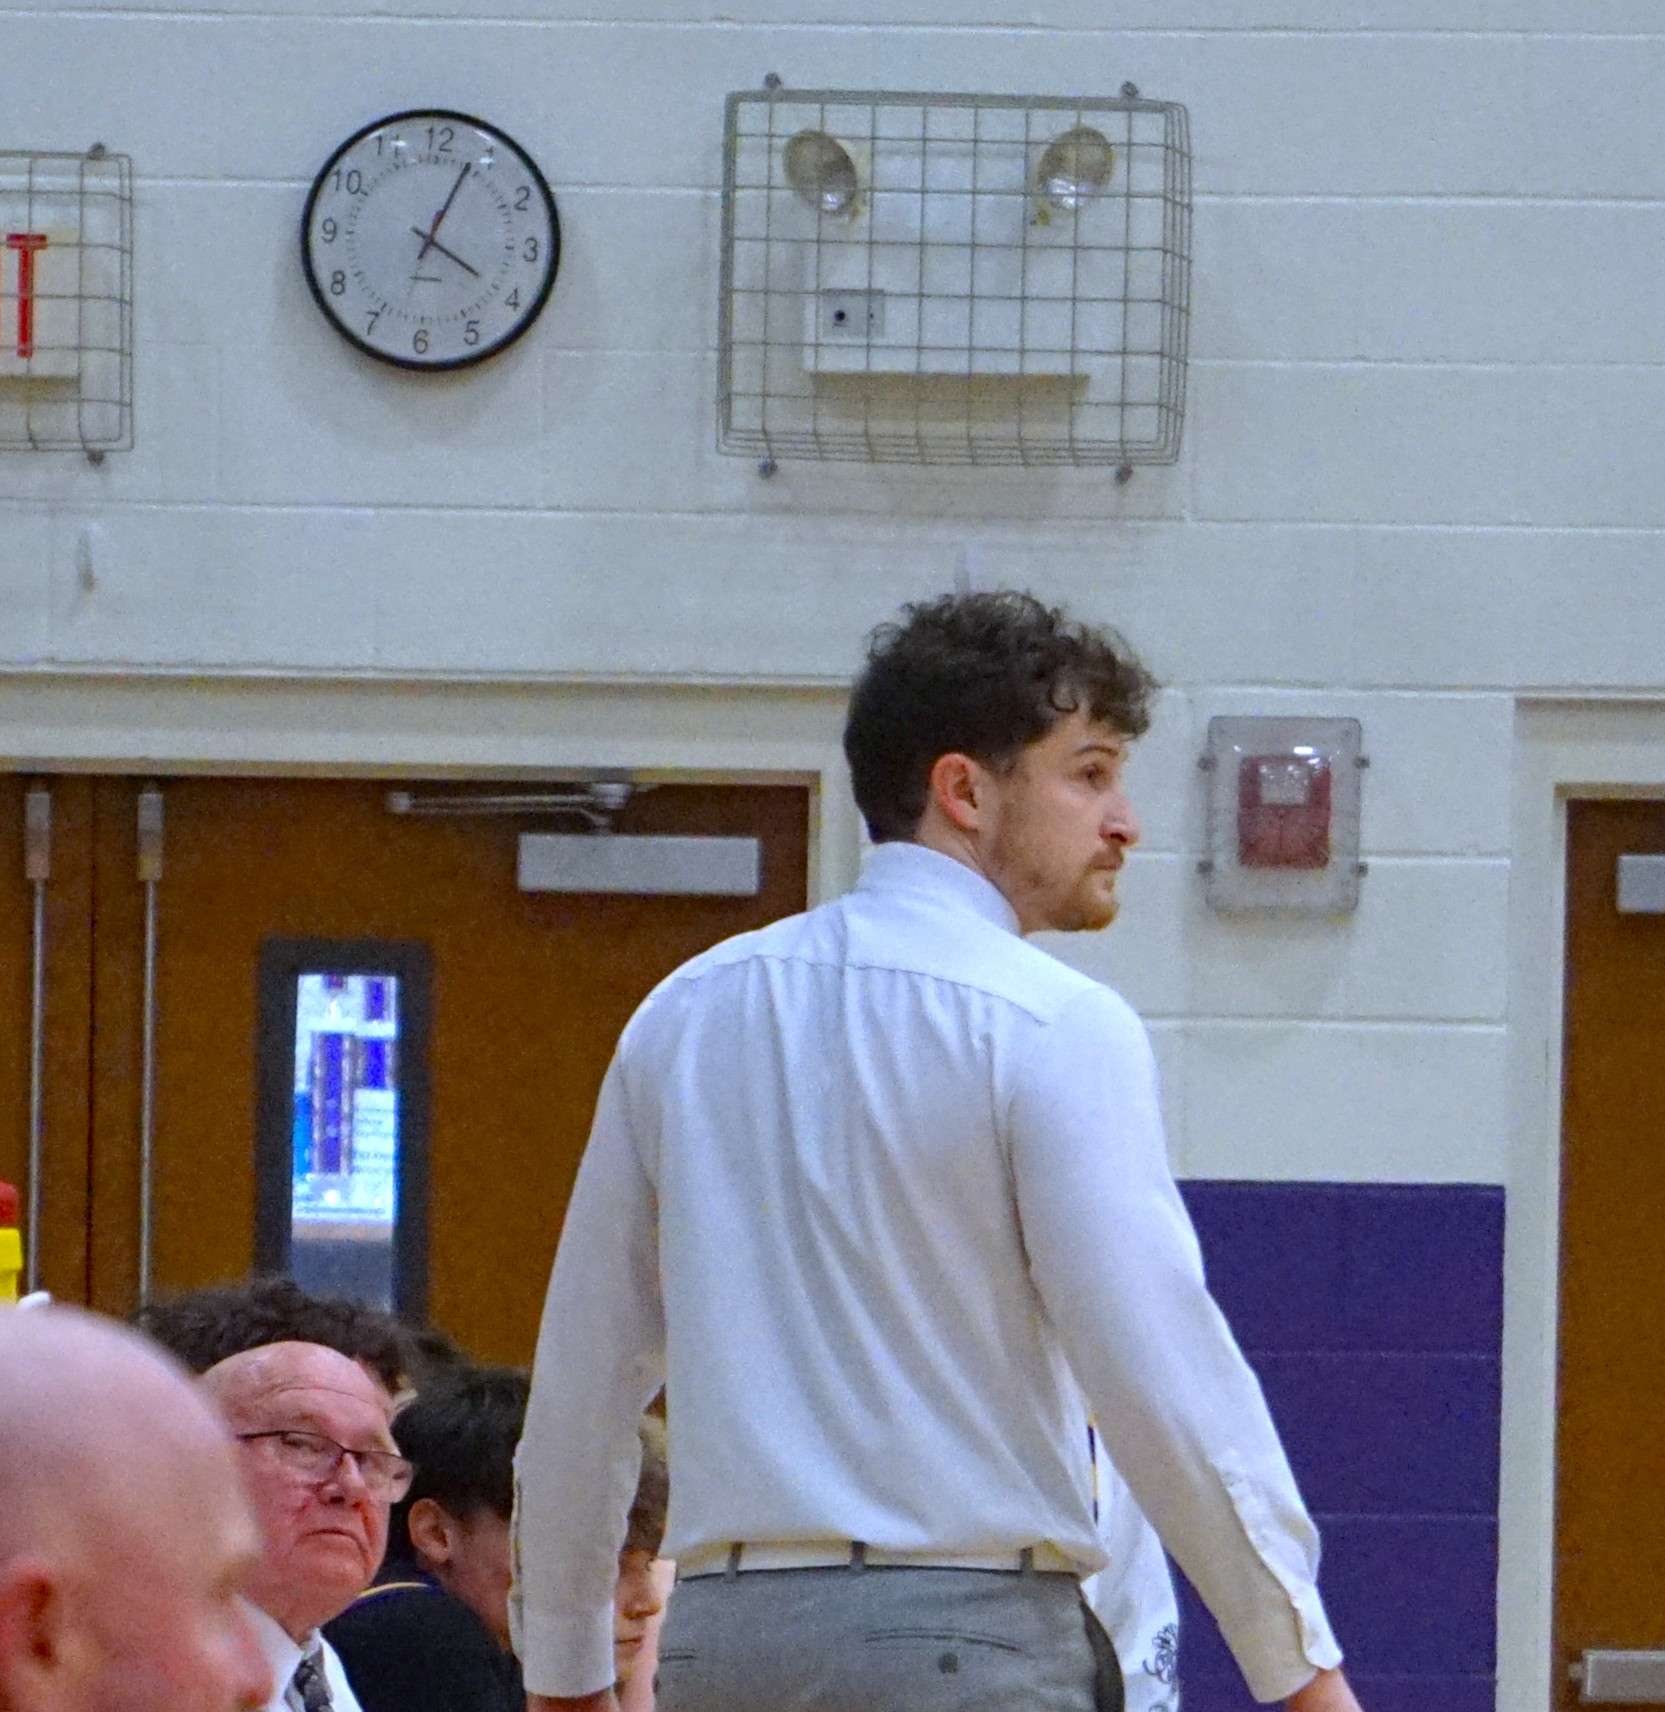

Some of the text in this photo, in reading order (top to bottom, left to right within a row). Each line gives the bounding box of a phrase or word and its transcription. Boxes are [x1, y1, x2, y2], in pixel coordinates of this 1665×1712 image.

[426, 127, 455, 152] 12
[333, 169, 363, 195] 10
[513, 185, 531, 211] 2
[321, 217, 337, 243] 9
[523, 237, 539, 262] 3
[330, 270, 346, 295] 8
[504, 287, 521, 311] 4
[366, 310, 380, 336] 7
[464, 319, 481, 346] 5
[412, 328, 429, 354] 6
